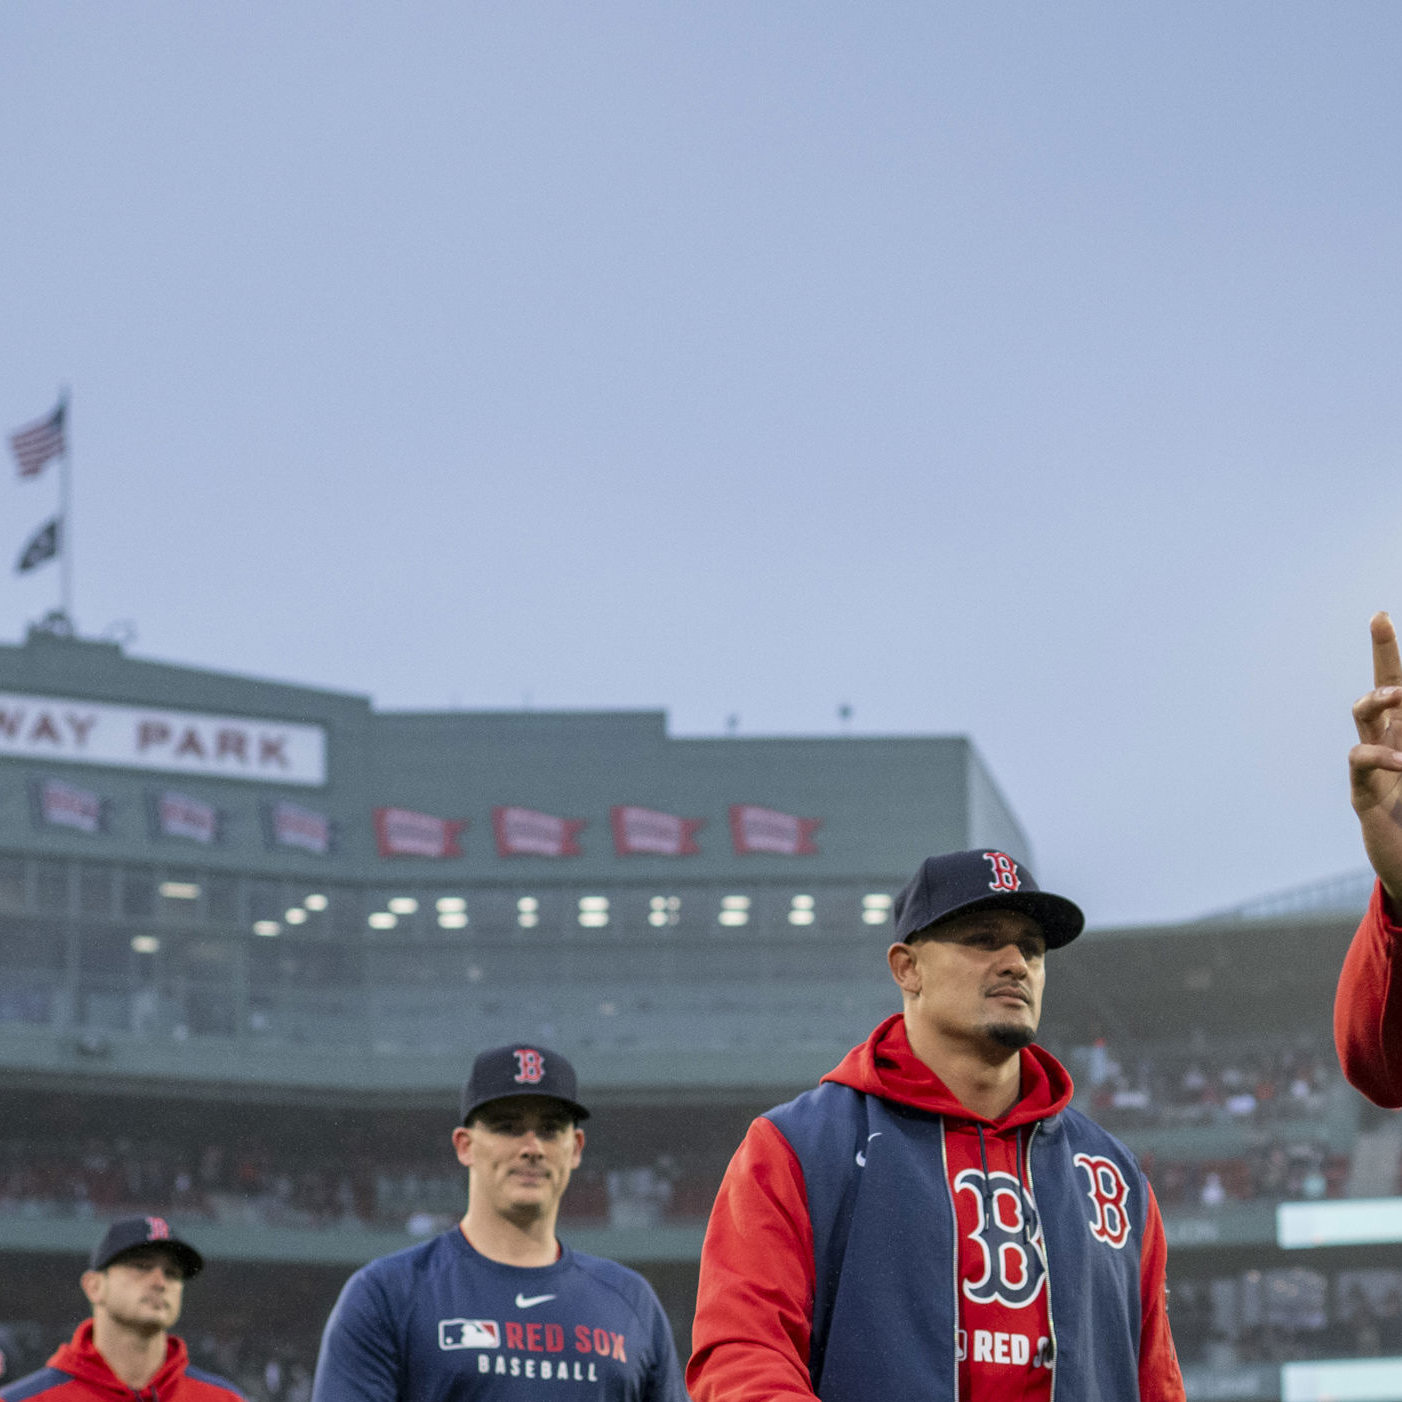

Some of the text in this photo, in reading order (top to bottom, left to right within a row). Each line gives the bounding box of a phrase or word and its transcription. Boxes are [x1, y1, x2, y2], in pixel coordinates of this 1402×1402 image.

[136, 718, 289, 770] PARK
[982, 850, 1020, 893] B
[513, 1048, 546, 1083] B
[1073, 1152, 1131, 1250] B
[954, 1168, 1048, 1309] B
[505, 1322, 627, 1363] RED SOX
[973, 1329, 1030, 1366] RED
[478, 1354, 598, 1382] BASEBALL
